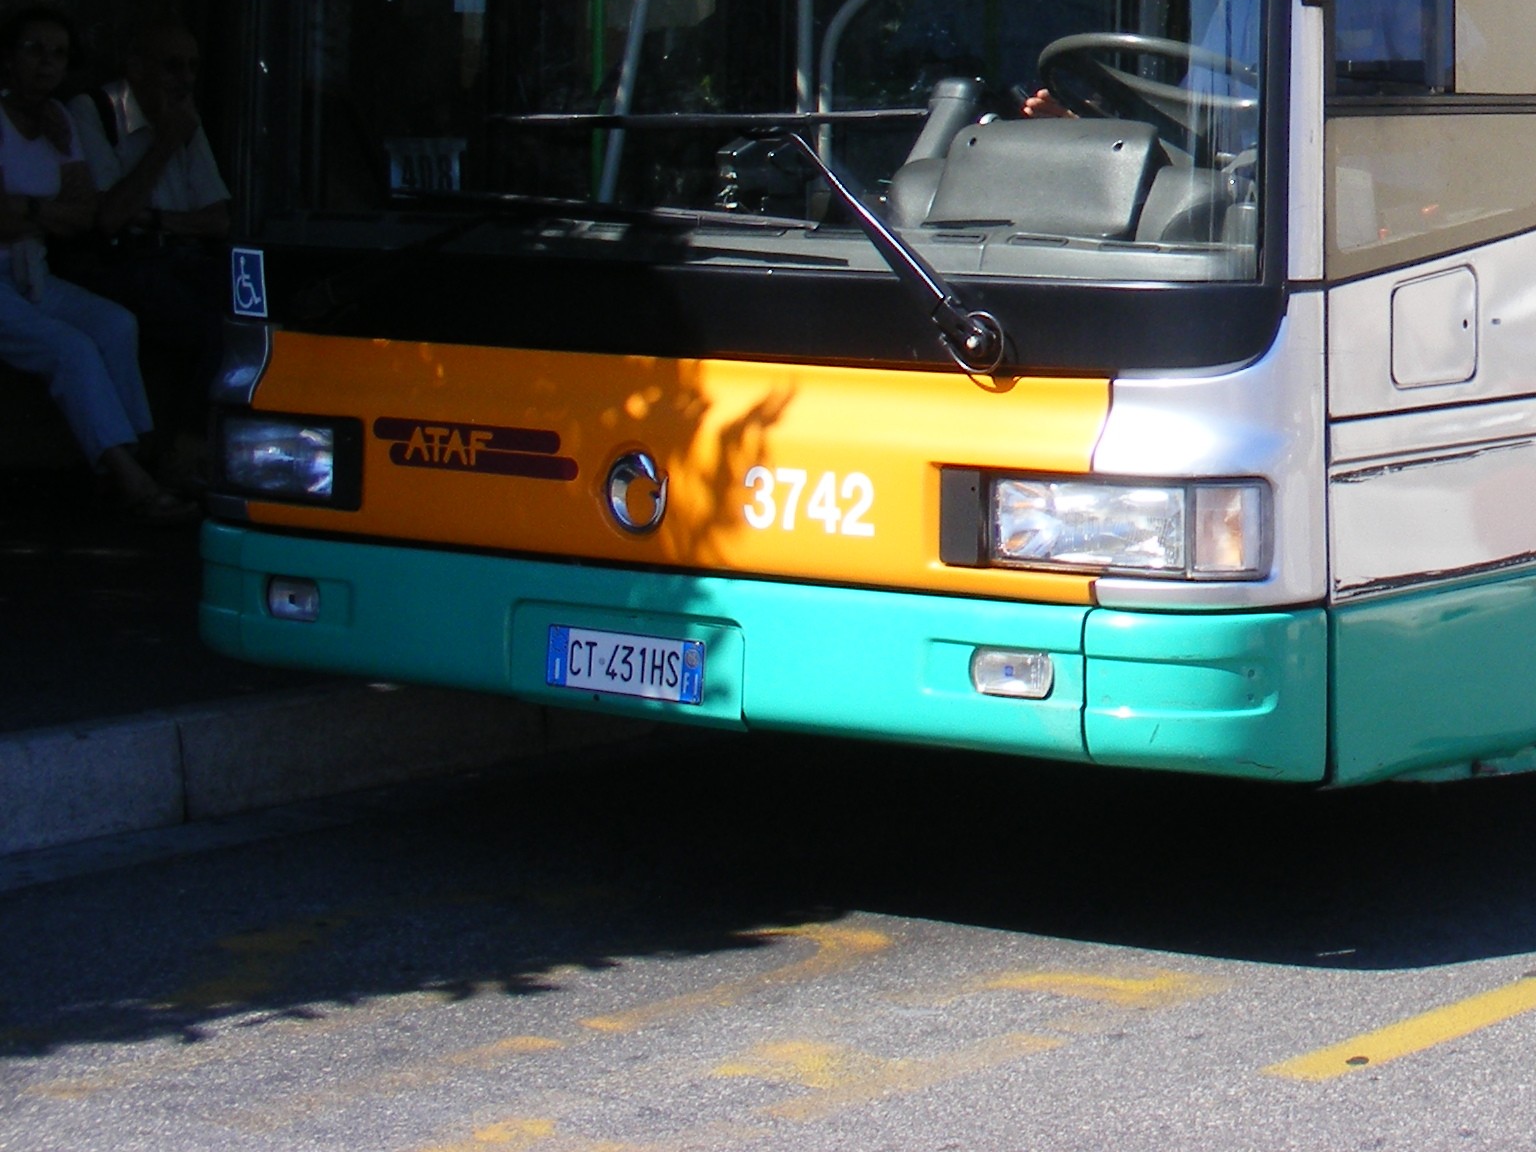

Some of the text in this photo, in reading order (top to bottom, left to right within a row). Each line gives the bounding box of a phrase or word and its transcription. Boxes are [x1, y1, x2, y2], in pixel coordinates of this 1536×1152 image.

[404, 425, 494, 466] ATAF
[743, 464, 876, 538] 3742
[568, 639, 598, 678] CT
[605, 644, 680, 688] 431HS
